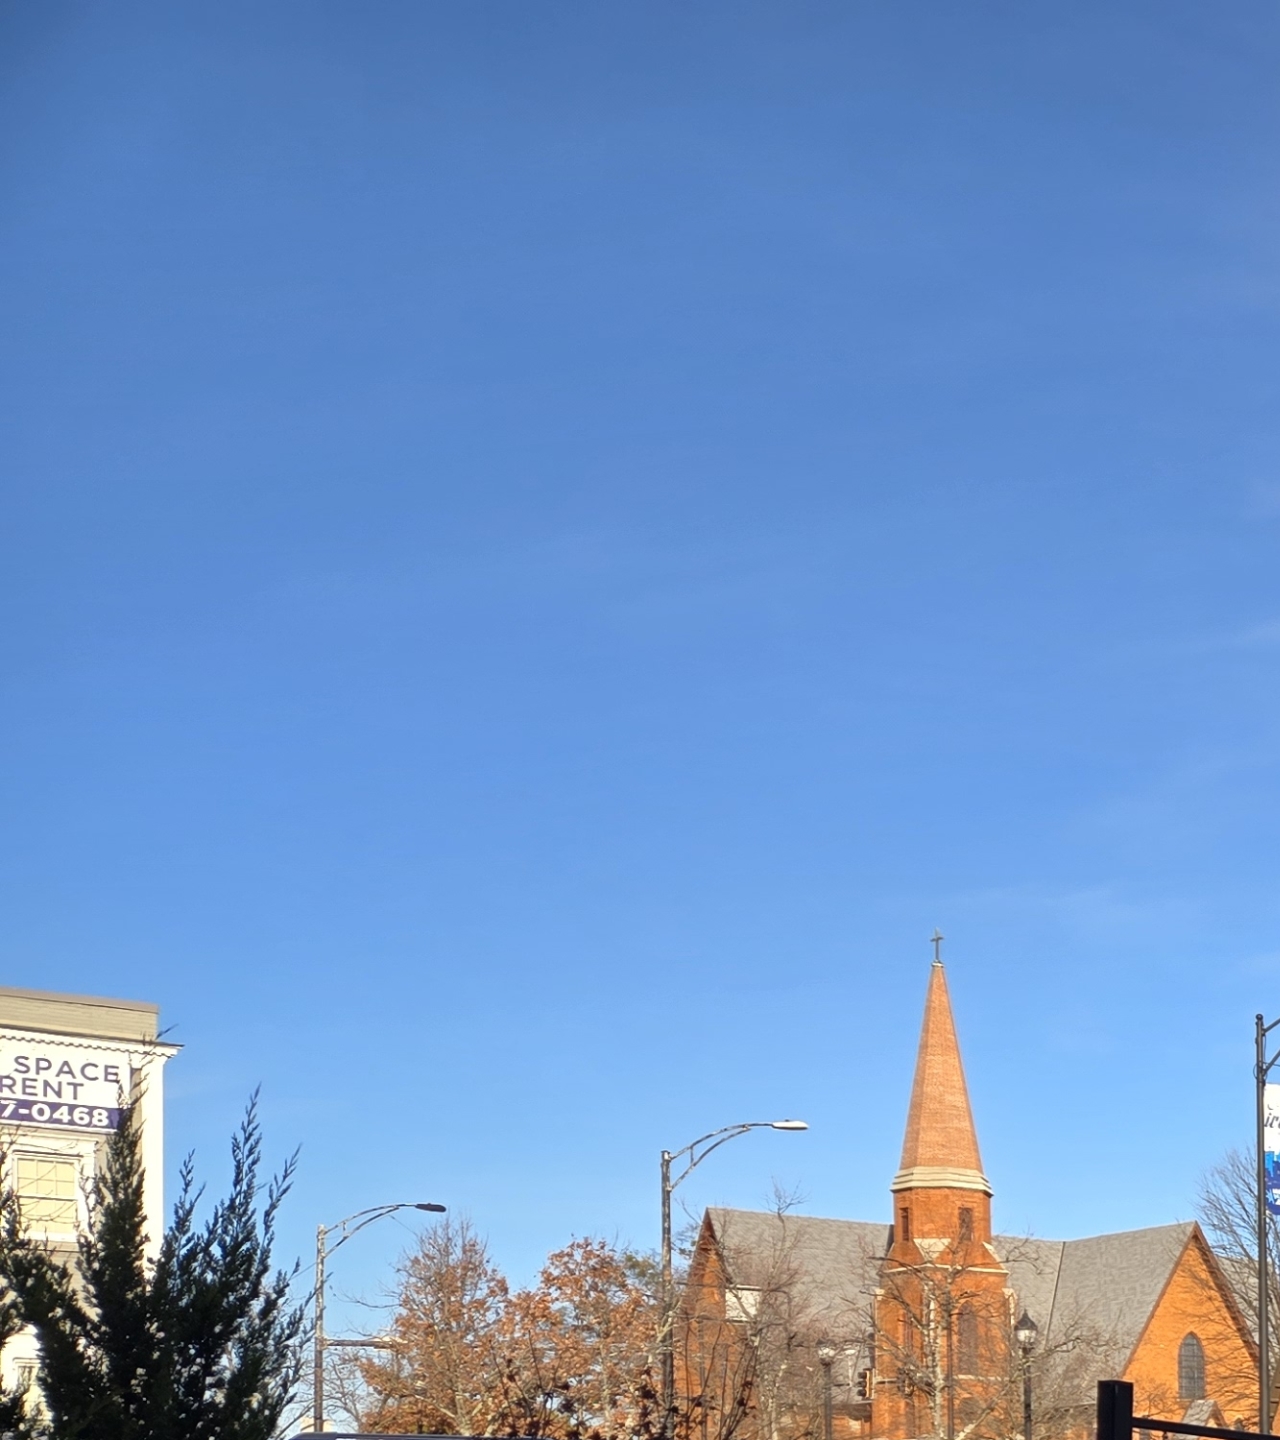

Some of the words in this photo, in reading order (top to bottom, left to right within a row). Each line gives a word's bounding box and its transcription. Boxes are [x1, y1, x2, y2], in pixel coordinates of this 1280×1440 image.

[14, 1055, 120, 1084] SPACE
[0, 1074, 84, 1100] RENT
[0, 1100, 109, 1127] 7-0468
